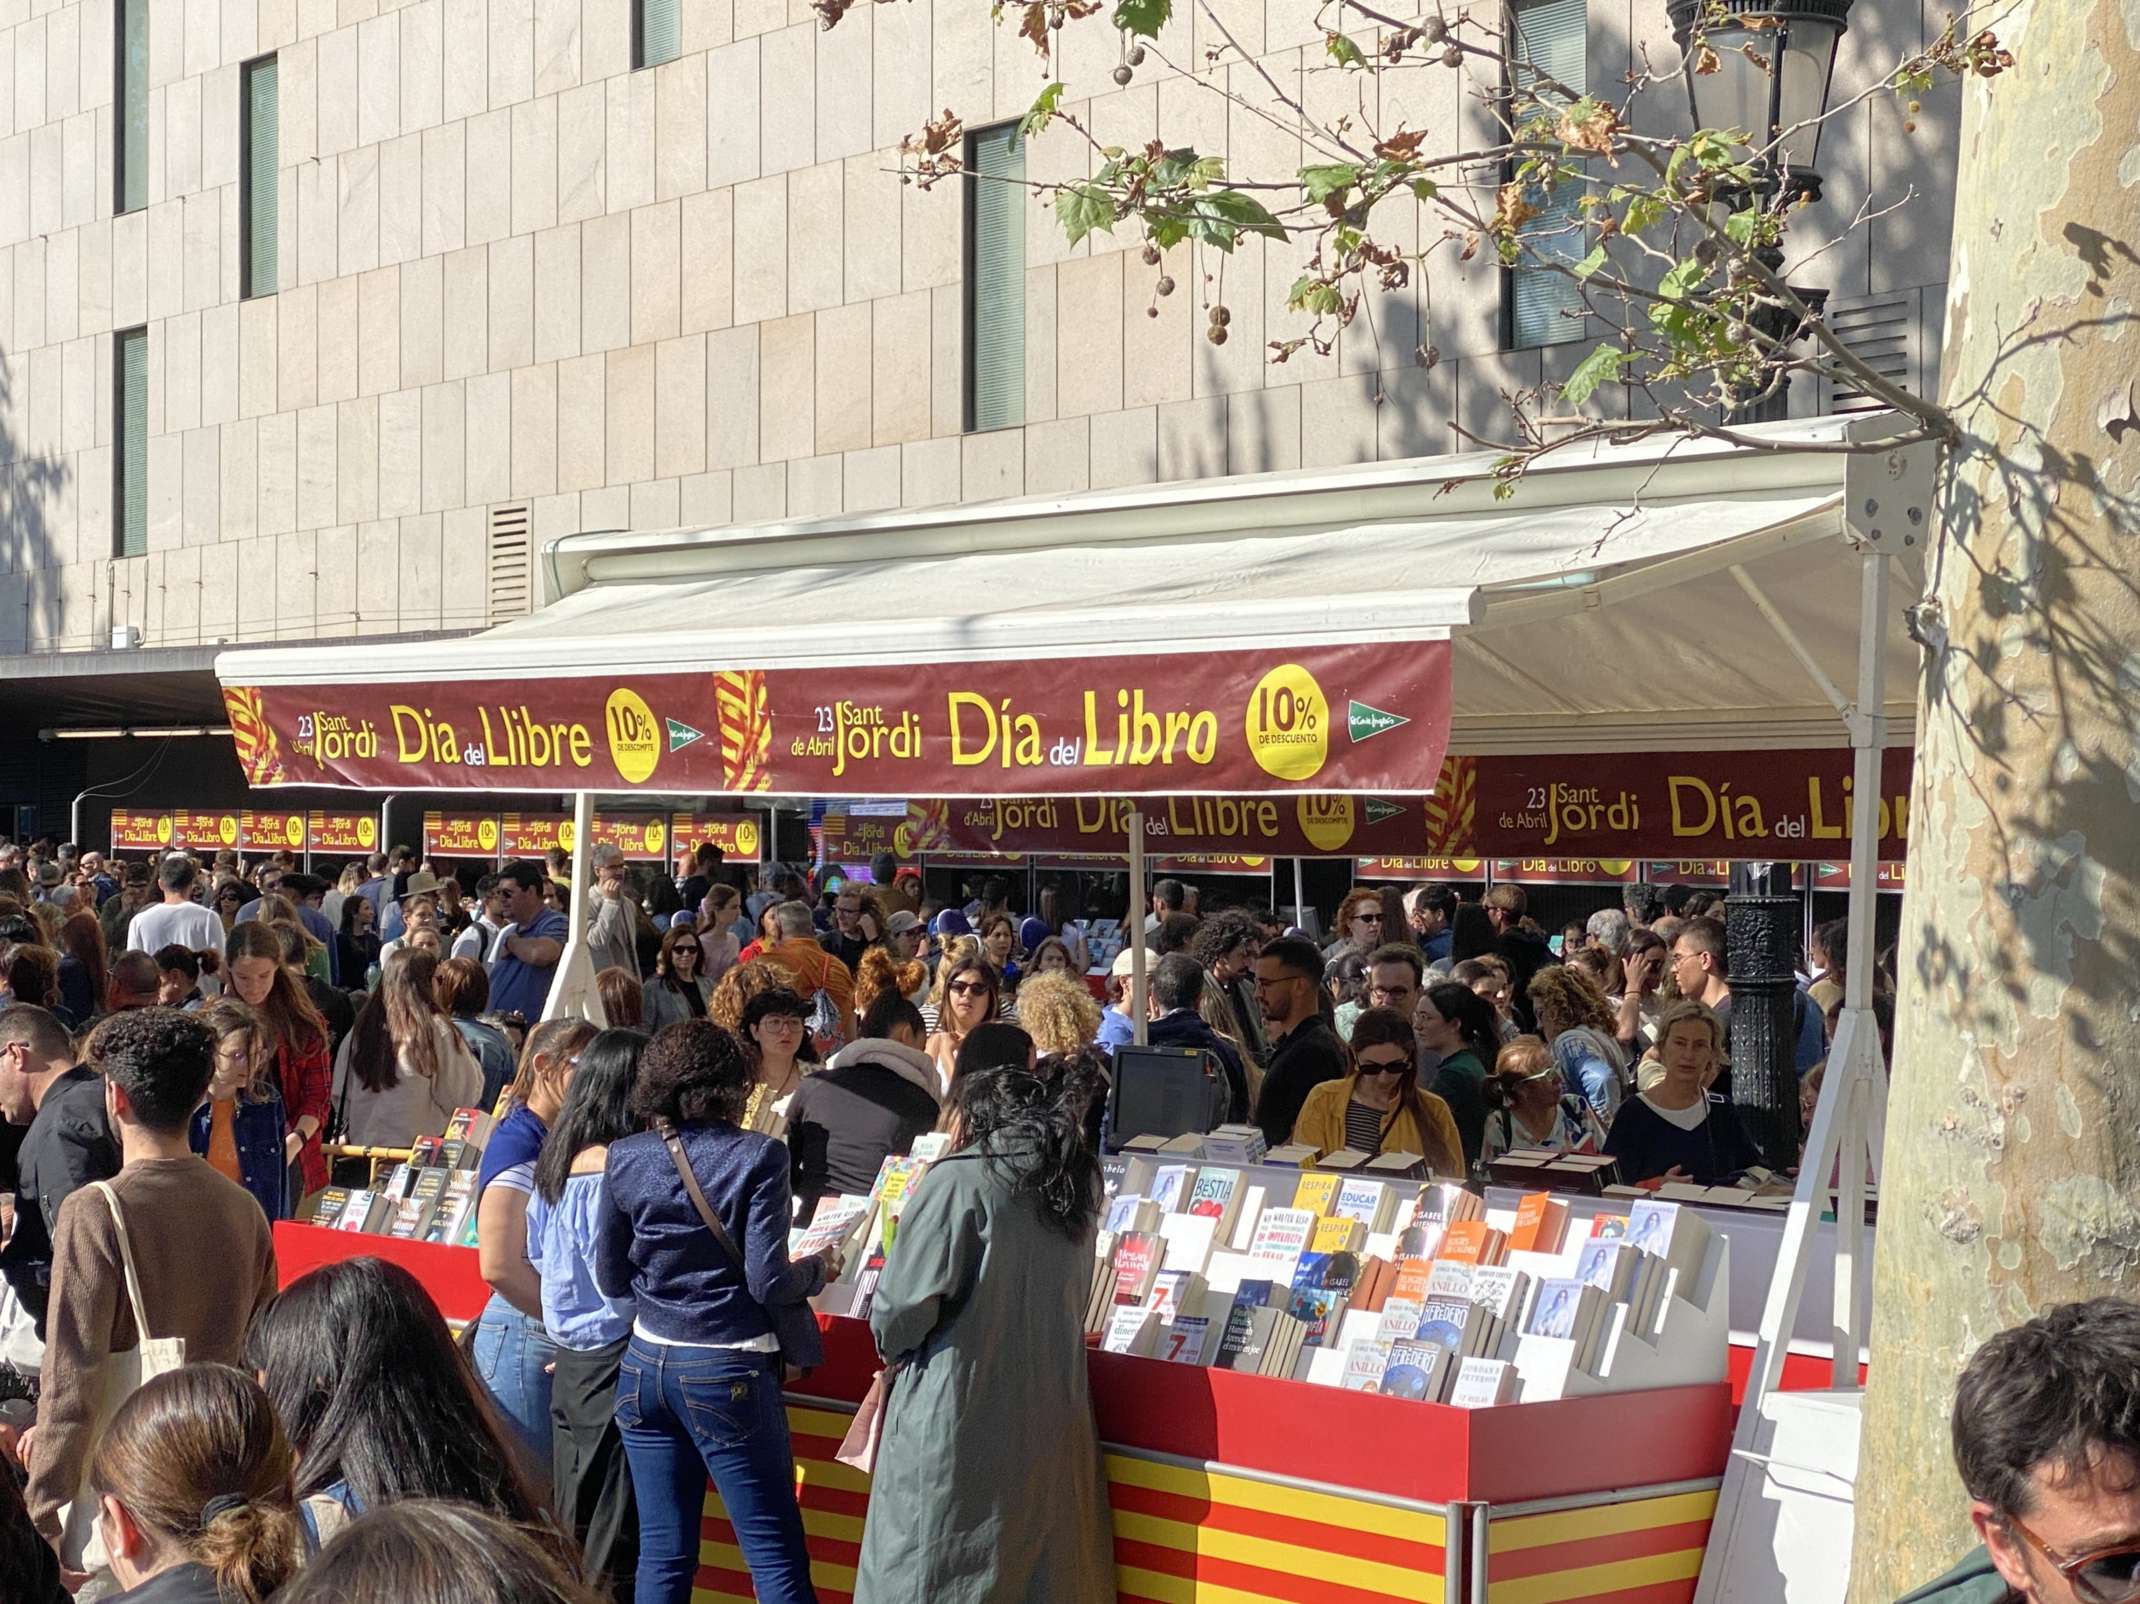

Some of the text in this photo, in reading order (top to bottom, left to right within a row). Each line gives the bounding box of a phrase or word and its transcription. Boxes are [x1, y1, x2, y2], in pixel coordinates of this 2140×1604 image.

[319, 711, 351, 731] Sant
[815, 706, 833, 732] 23
[842, 701, 884, 725] Sant
[1258, 686, 1316, 732] 10%
[298, 716, 313, 737] 23
[390, 704, 592, 767] Dia del Llibre
[610, 706, 652, 742] 10%
[948, 688, 1218, 769] Día del Libro
[313, 712, 377, 771] Jordi
[617, 743, 624, 752] DE
[791, 736, 834, 757] de Abril
[832, 702, 920, 776] Jordi
[1259, 734, 1317, 745] DE DESCUENTO
[1527, 788, 1546, 808] 23
[1558, 783, 1599, 803] Sant
[964, 811, 994, 826] d'Abril
[1146, 812, 1169, 836] del
[1168, 796, 1279, 837] Llibre
[1544, 784, 1639, 845] Jordi
[1668, 776, 1768, 839] Día
[1775, 815, 1805, 838] del
[1499, 812, 1547, 828] de Abril
[1558, 859, 1596, 873] Libro
[1879, 871, 1889, 880] del
[1341, 1192, 1377, 1204] EDUCAR
[1152, 1288, 1168, 1312] 7
[1167, 1334, 1186, 1360] 7
[1386, 1348, 1437, 1375] HEREDERO
